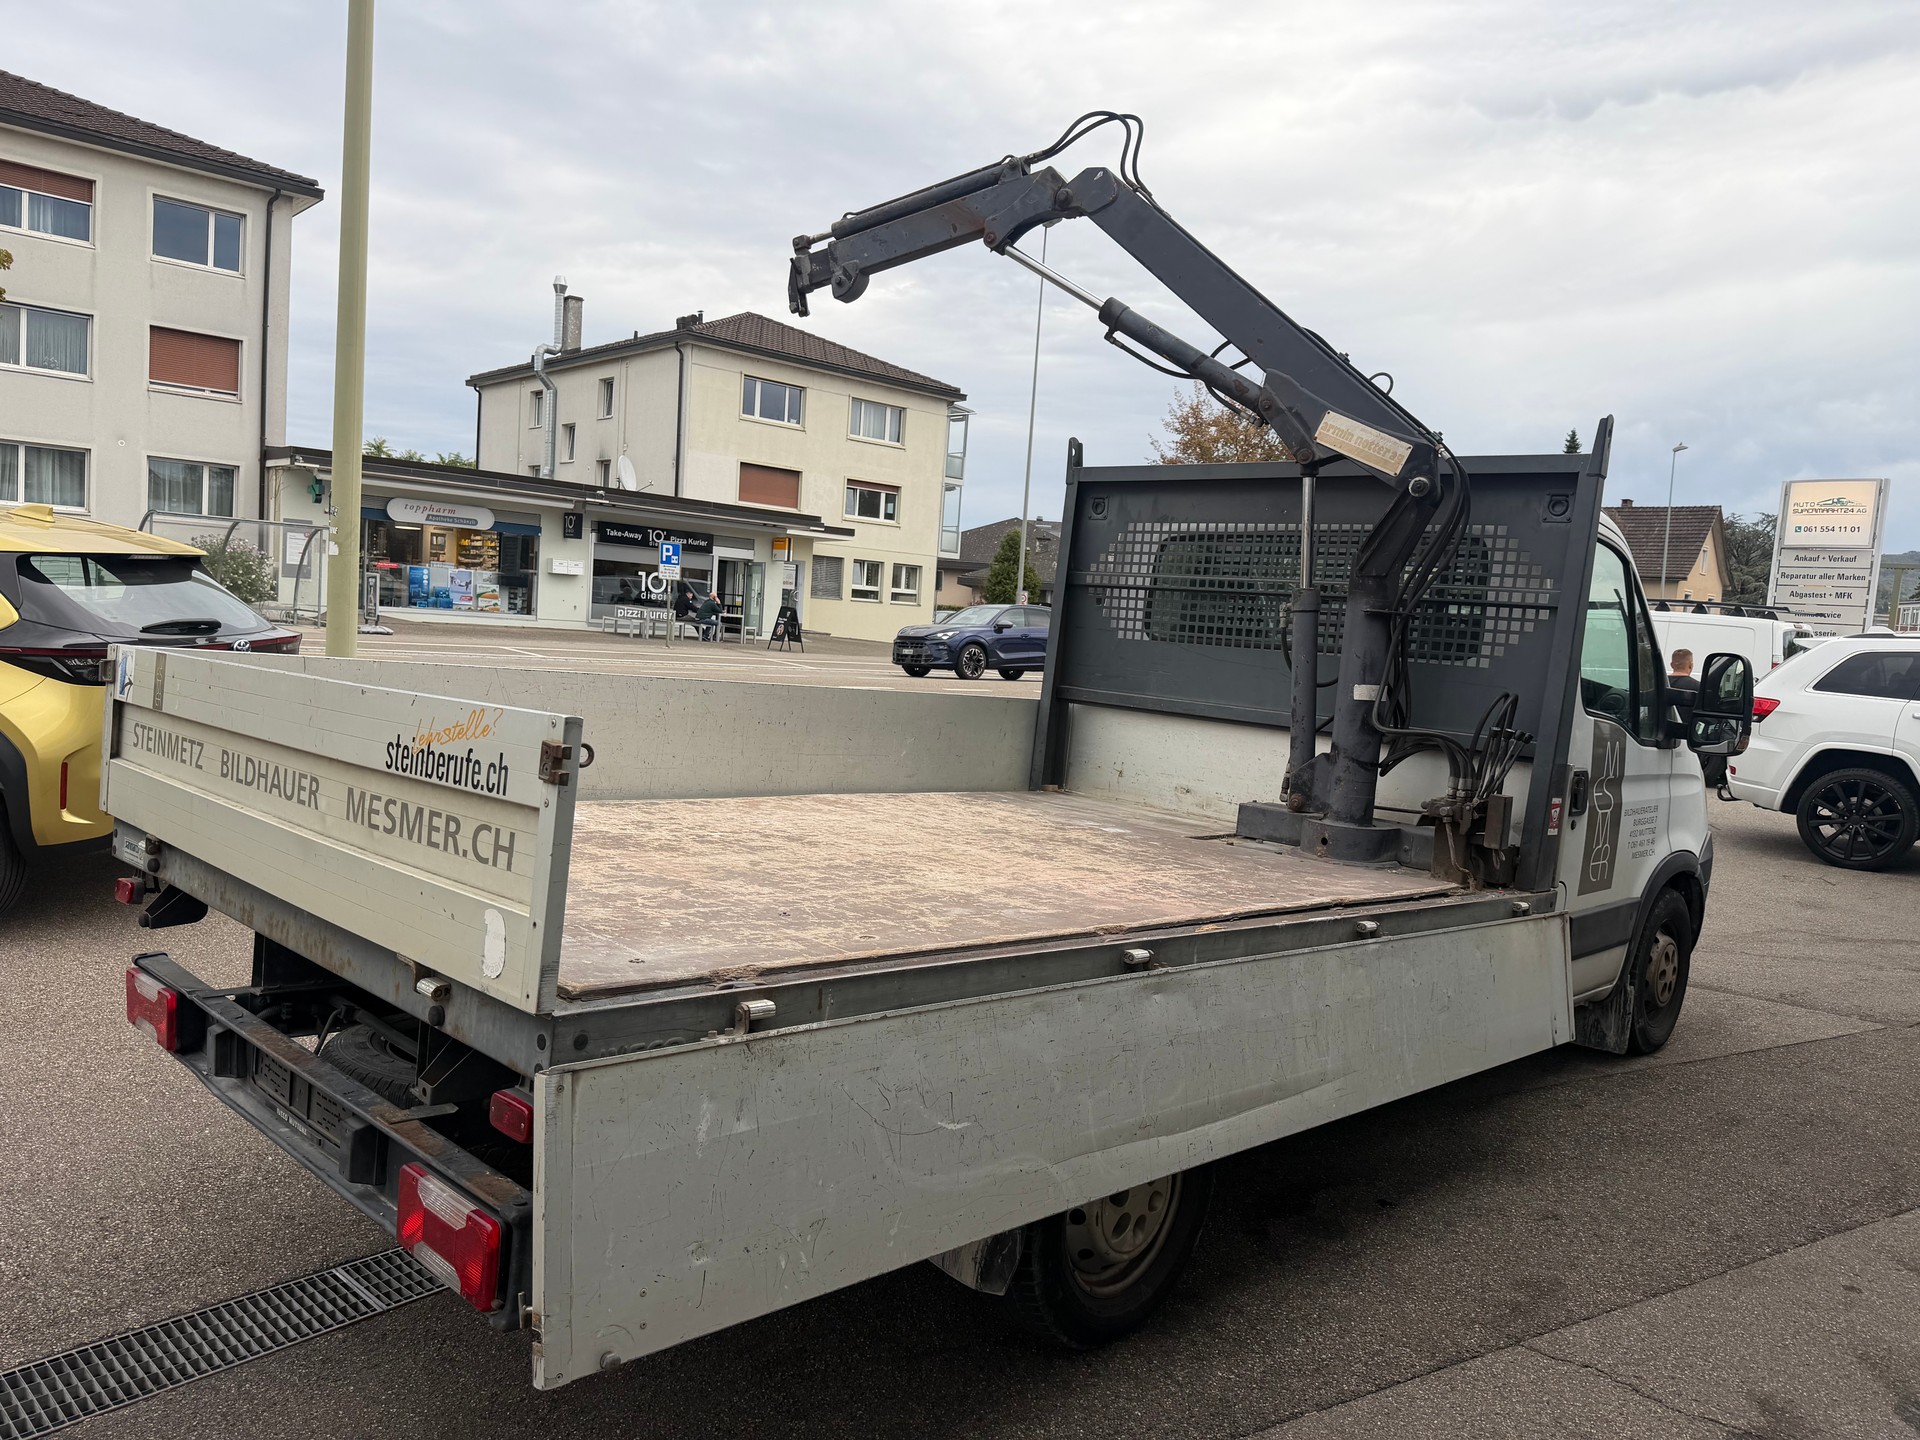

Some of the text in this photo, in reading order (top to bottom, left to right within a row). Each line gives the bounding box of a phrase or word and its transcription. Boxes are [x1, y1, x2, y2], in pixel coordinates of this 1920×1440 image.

[404, 504, 456, 515] toppharm
[429, 515, 453, 523] Apotheke
[605, 528, 643, 541] Take-Away
[670, 536, 687, 544] Pizza
[688, 539, 708, 547] Kurier
[662, 544, 673, 561] P
[1793, 554, 1820, 562] Ankauf
[1828, 555, 1857, 563] Verkauf
[1780, 572, 1817, 580] Reparatur
[1837, 573, 1866, 581] Marken
[1789, 590, 1826, 600] Abgastest
[412, 707, 504, 755] Lehrstelle?
[385, 734, 509, 796] steinberufe.ch
[133, 722, 516, 872] STEINMETZ BILDHAUER MESMER.CH
